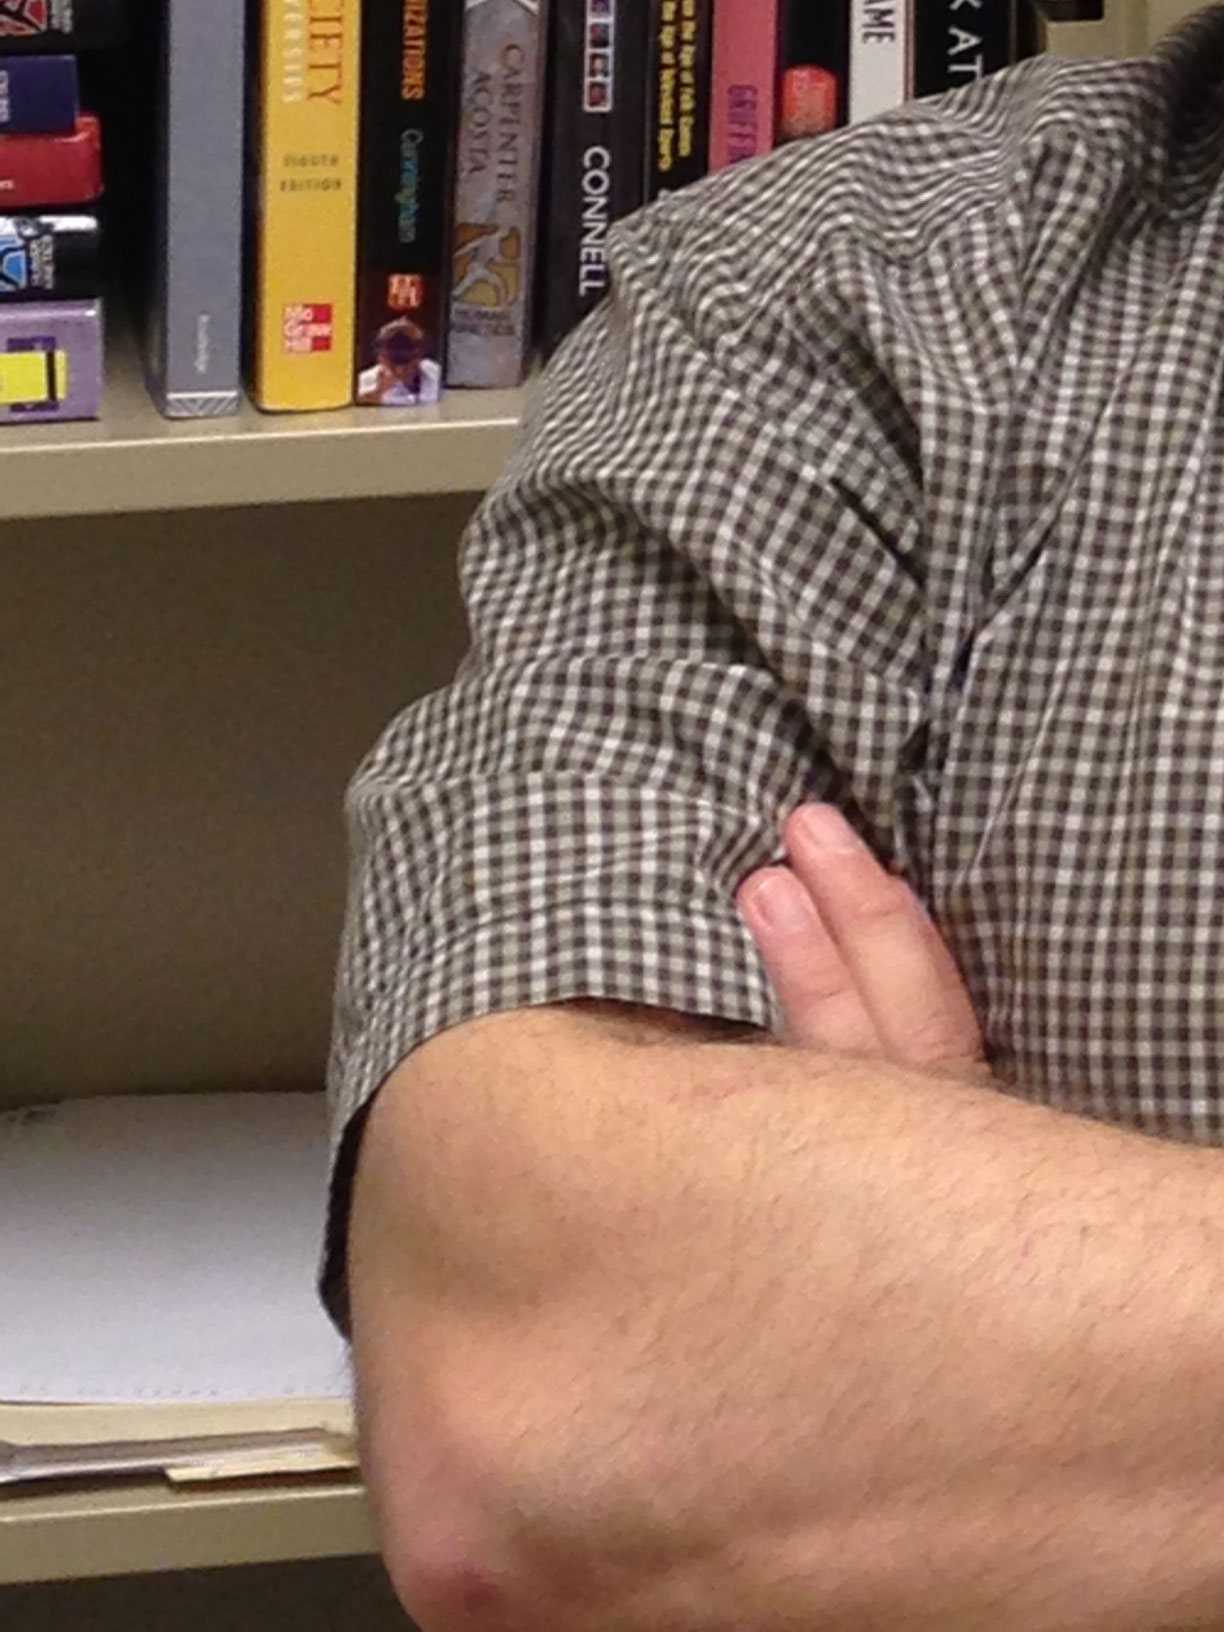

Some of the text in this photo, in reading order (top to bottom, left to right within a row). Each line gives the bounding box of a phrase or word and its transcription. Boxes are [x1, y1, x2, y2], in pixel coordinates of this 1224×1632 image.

[395, 128, 425, 243] Cunningham
[468, 71, 493, 174] ACOSTA
[496, 43, 525, 204] CARPENTER
[580, 144, 613, 297] CONNELL
